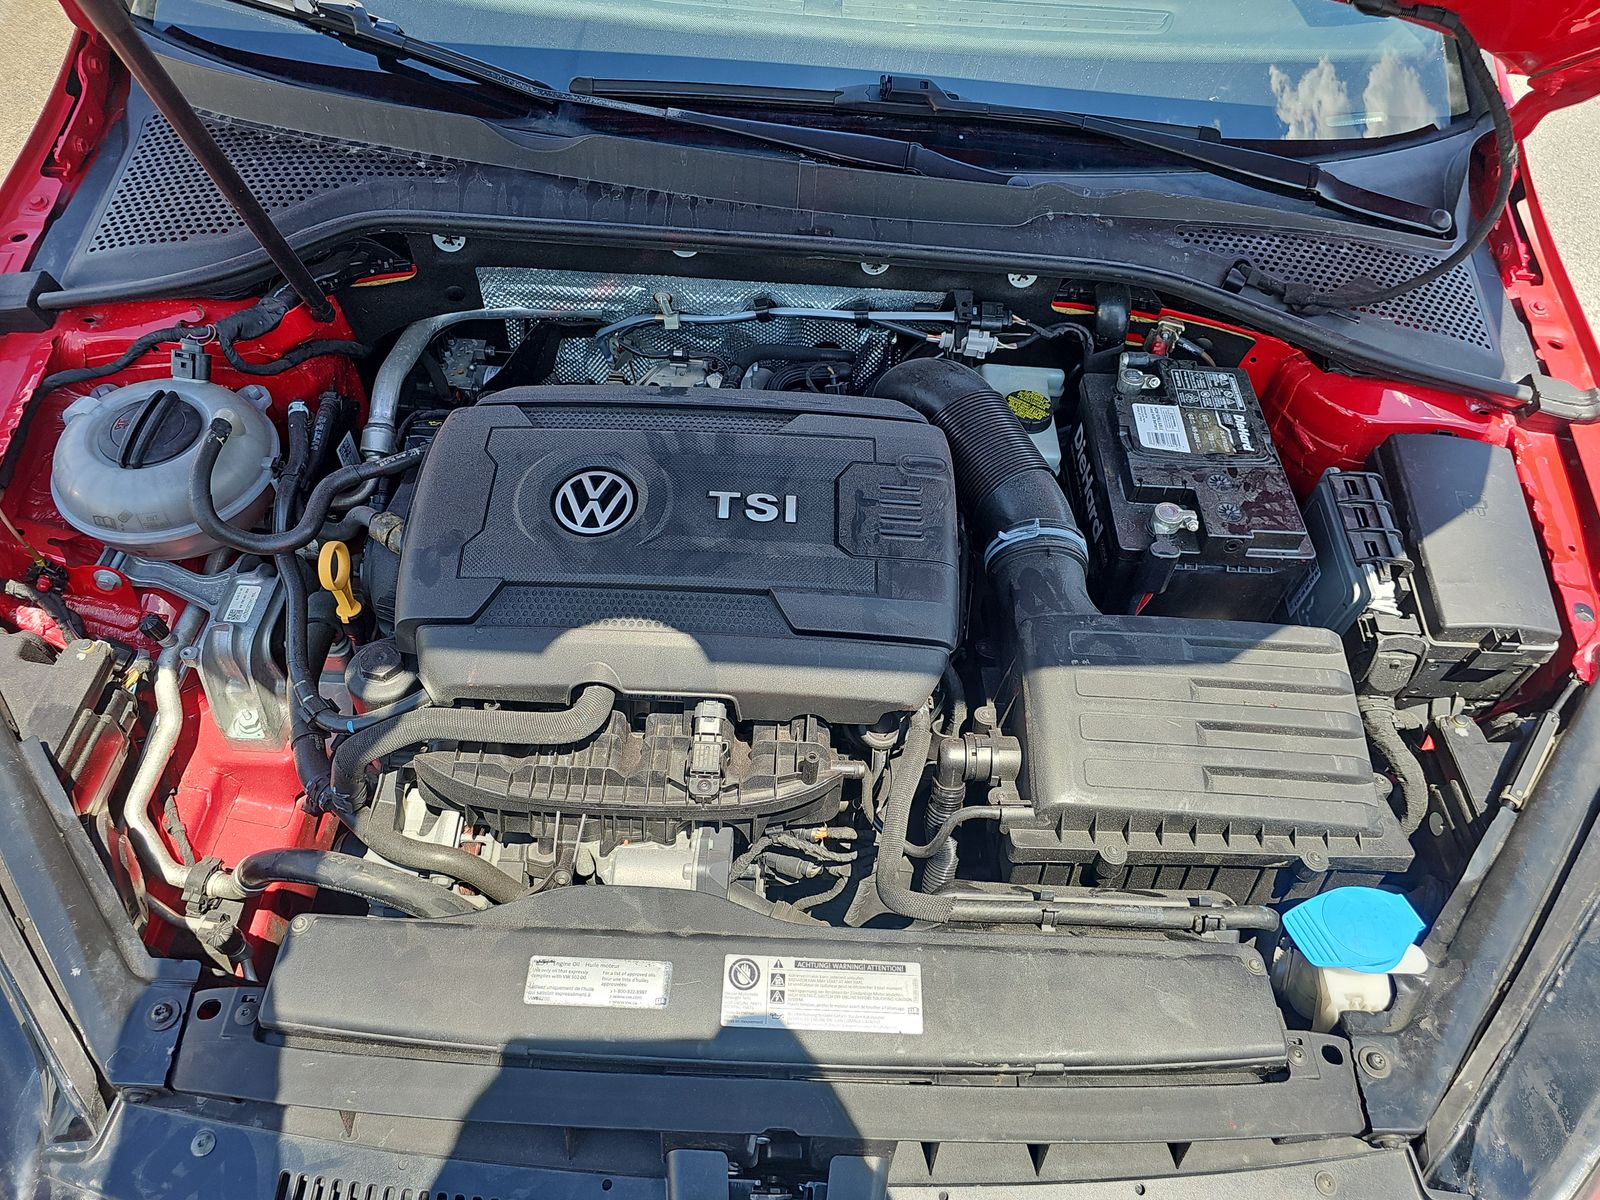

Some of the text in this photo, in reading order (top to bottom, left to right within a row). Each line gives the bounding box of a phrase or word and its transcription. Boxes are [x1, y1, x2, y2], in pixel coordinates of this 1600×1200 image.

[1233, 414, 1255, 451] DieHard
[1074, 422, 1104, 543] DieHard
[554, 470, 635, 534] VW
[708, 490, 798, 524] TSI
[796, 961, 905, 973] ACHTUNG! WARNING! ATTENTION!
